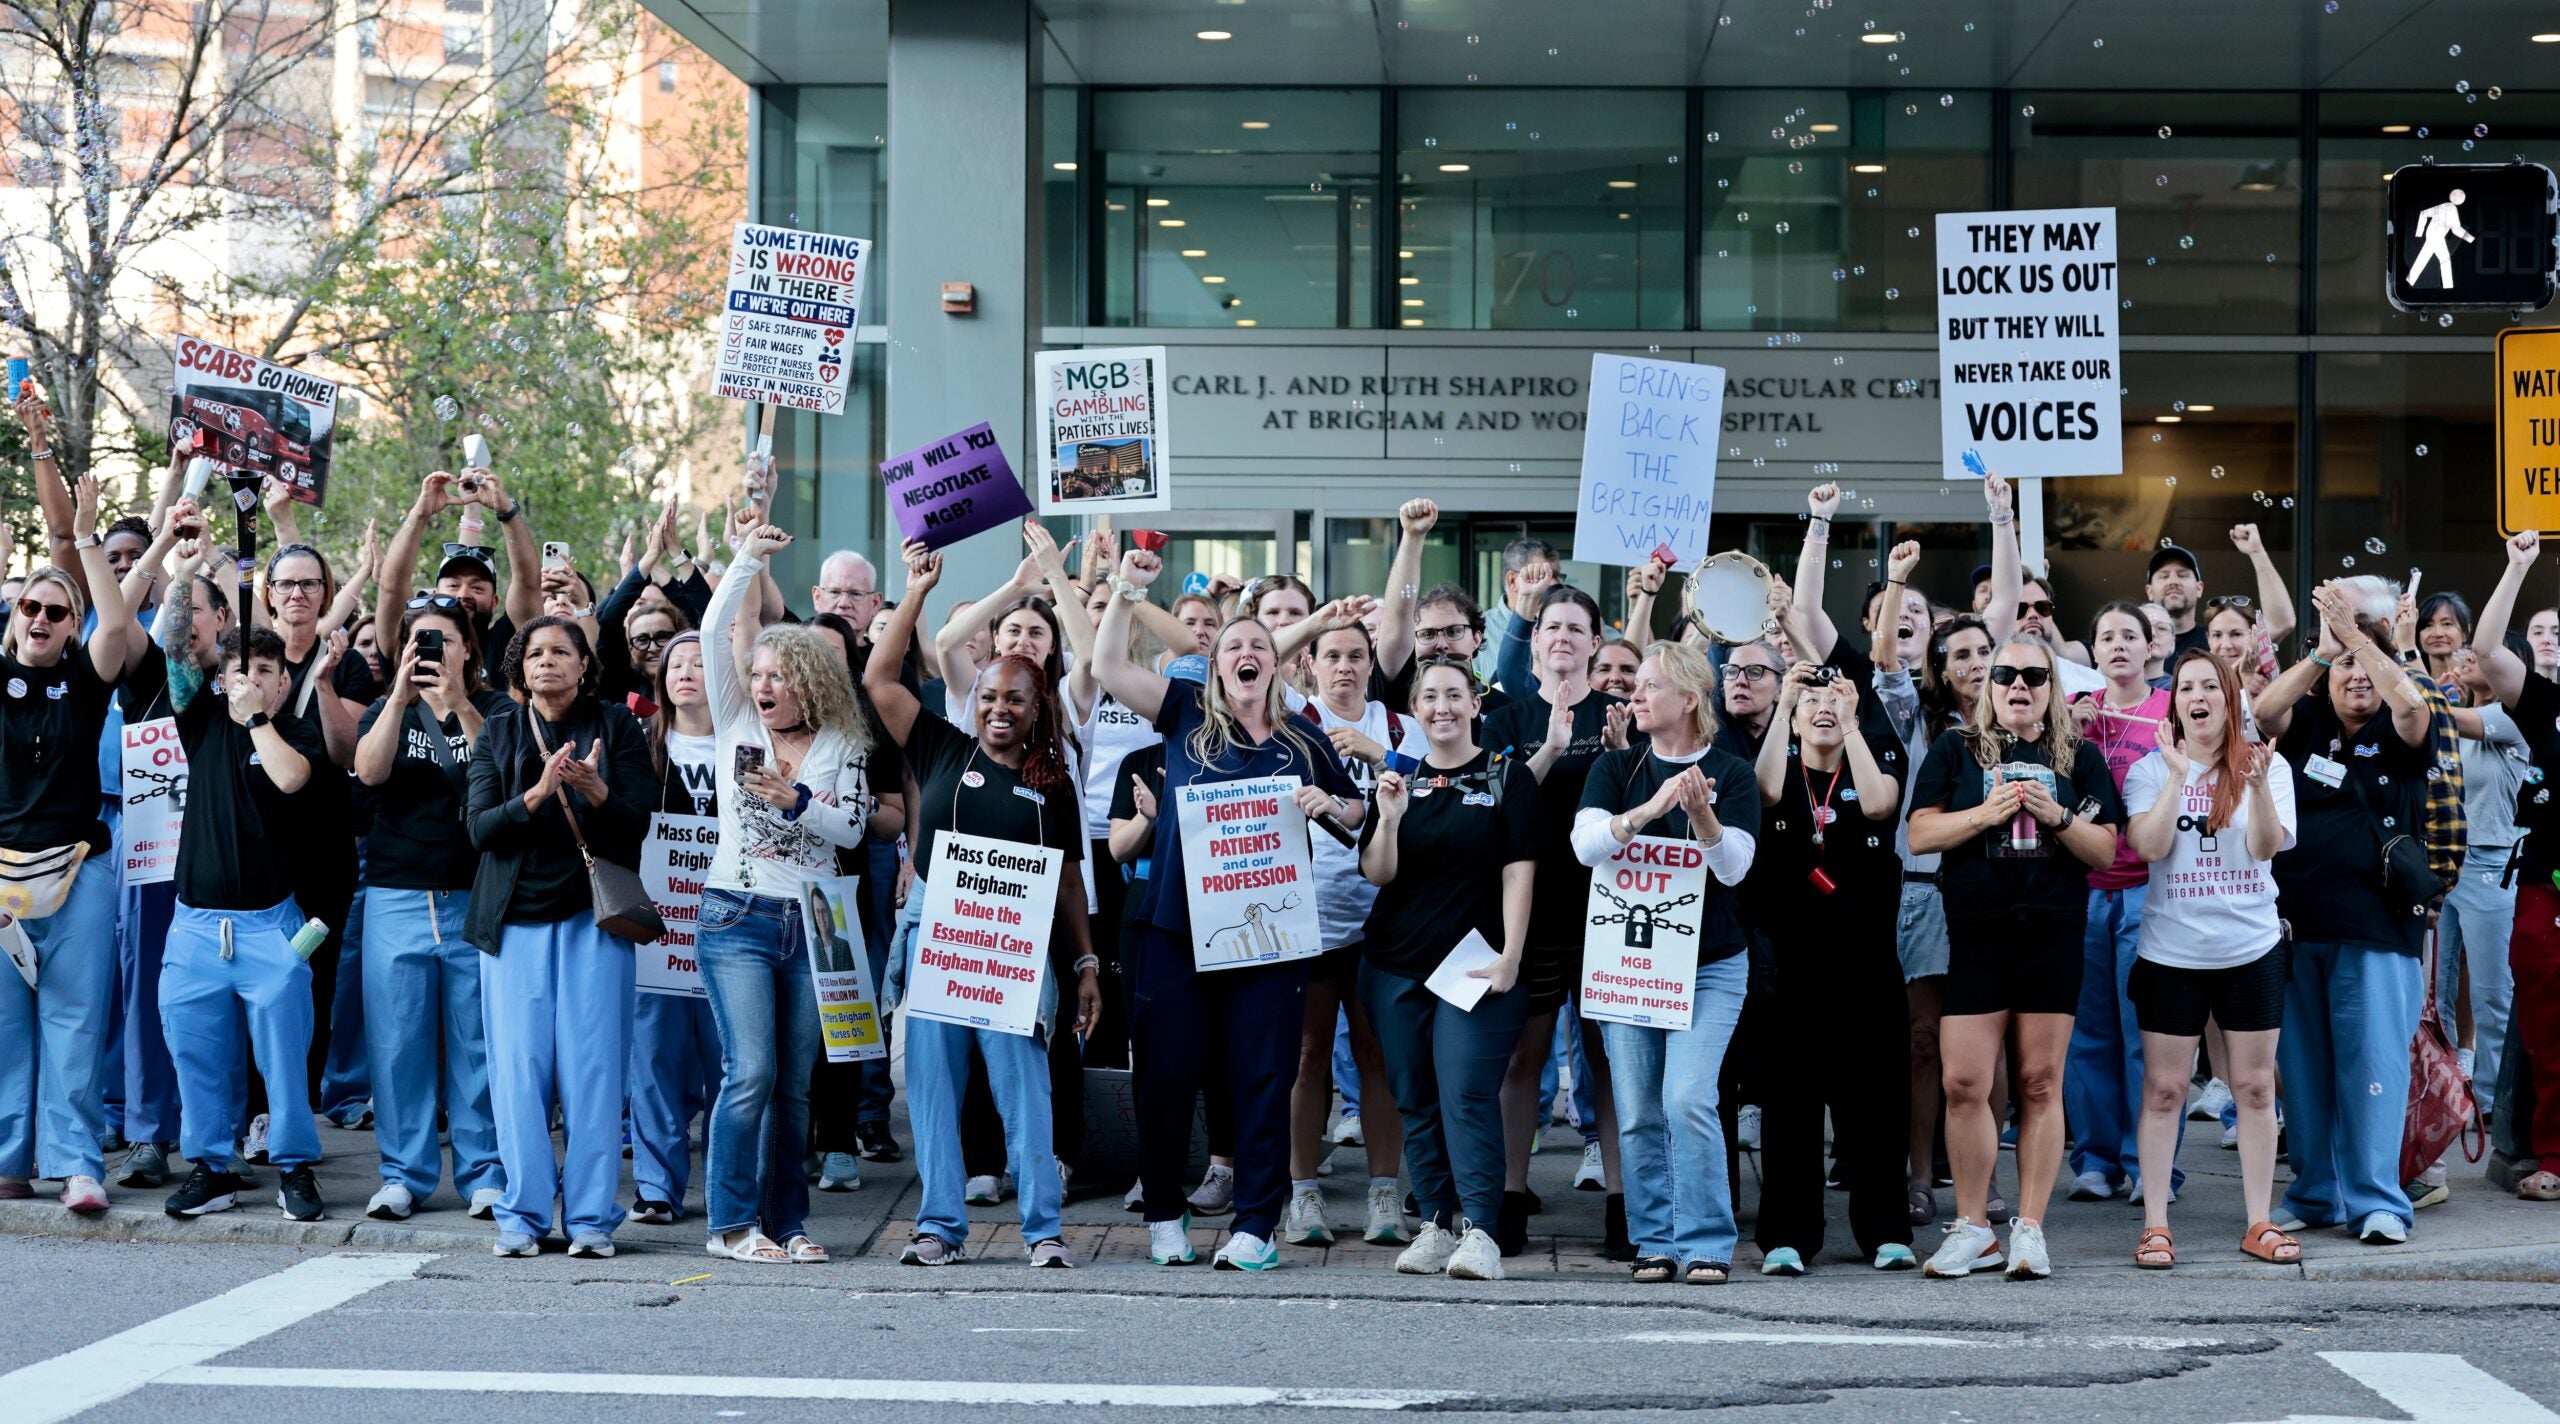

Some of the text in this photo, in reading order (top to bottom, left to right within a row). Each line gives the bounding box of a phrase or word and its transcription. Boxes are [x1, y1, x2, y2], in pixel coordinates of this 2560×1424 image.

[743, 228, 860, 260] SOMETHING
[1967, 222, 2102, 253] THEY MAY
[749, 249, 855, 283] IS WRONG
[1942, 262, 2116, 295] LOCK US OUT
[750, 274, 839, 302] IN THERE
[734, 293, 850, 325] IF WE'RE OUT HERE
[748, 320, 817, 340] SAFE STAFFING
[1948, 314, 2105, 341] BUT THEY WILL
[745, 336, 804, 356] FAIR WAGES
[178, 340, 336, 404] SCABS GO HOME!
[741, 362, 815, 381] PROTECT PATIENTS
[743, 352, 813, 371] RESPECT NURSES
[1954, 359, 2111, 384] NEVER TAKE OUR
[720, 372, 825, 399] INVEST IN NURSES.
[1066, 362, 1130, 391] MGB
[1171, 375, 1249, 396] CARL
[1256, 376, 1276, 399] J.
[1286, 375, 1350, 396] AND
[1360, 376, 1439, 396] RUTH
[1449, 376, 1577, 397] SHAPIRO
[1724, 377, 1857, 399] ASCULAR
[1619, 362, 1711, 402] BRING
[2513, 369, 2560, 398] WAT
[192, 398, 224, 416] RAT-CO
[718, 385, 825, 412] INVEST IN CARE.
[1056, 394, 1146, 418] GAMBLING
[1058, 421, 1149, 441] PATIENTS LIVES
[1080, 415, 1104, 423] WITH
[1262, 410, 1299, 430] AT
[1309, 410, 1444, 431] BRIGHAM
[1456, 410, 1521, 431] AND
[1721, 412, 1822, 433] SPITAL
[1620, 400, 1700, 446] BACK
[1965, 400, 2099, 442] VOICES
[2529, 418, 2560, 447] TU
[883, 429, 996, 486] NOW WILL YOU
[1625, 451, 1679, 485] THE
[903, 464, 993, 508] NEGOTIATE
[923, 497, 974, 530] MGB?
[1591, 482, 1710, 524] BRIGHAM
[1098, 711, 1139, 725] RSES
[126, 722, 179, 749] LOC
[152, 746, 188, 767] OU
[407, 743, 426, 759] AS
[1247, 781, 1293, 795] Nurses
[1206, 797, 1279, 823] FIGHTING
[2187, 798, 2214, 813] OU
[656, 822, 692, 844] Mass
[1221, 821, 1268, 836] for our
[1209, 831, 1281, 857] PATIENTS
[127, 854, 178, 870] Brigha
[946, 842, 1048, 875] Mass General
[1222, 855, 1274, 871] and our
[2196, 857, 2221, 867] MGB
[956, 870, 1028, 899] Brigham:
[1201, 863, 1297, 894] PROFESSION
[1616, 868, 1672, 894] OUT
[954, 898, 1022, 926] Value the
[932, 921, 1033, 955] Essential Care
[920, 947, 1036, 983] Brigham Nurses
[1621, 956, 1653, 970] MGB
[848, 989, 859, 1000] PAY
[946, 979, 1004, 1006] Provide
[1591, 970, 1684, 994] disrespecting
[1584, 987, 1689, 1012] Brigham nurses
[838, 1011, 871, 1024] Brigham
[970, 1017, 988, 1025] MNA
[830, 1028, 865, 1039] Nurses 0%
